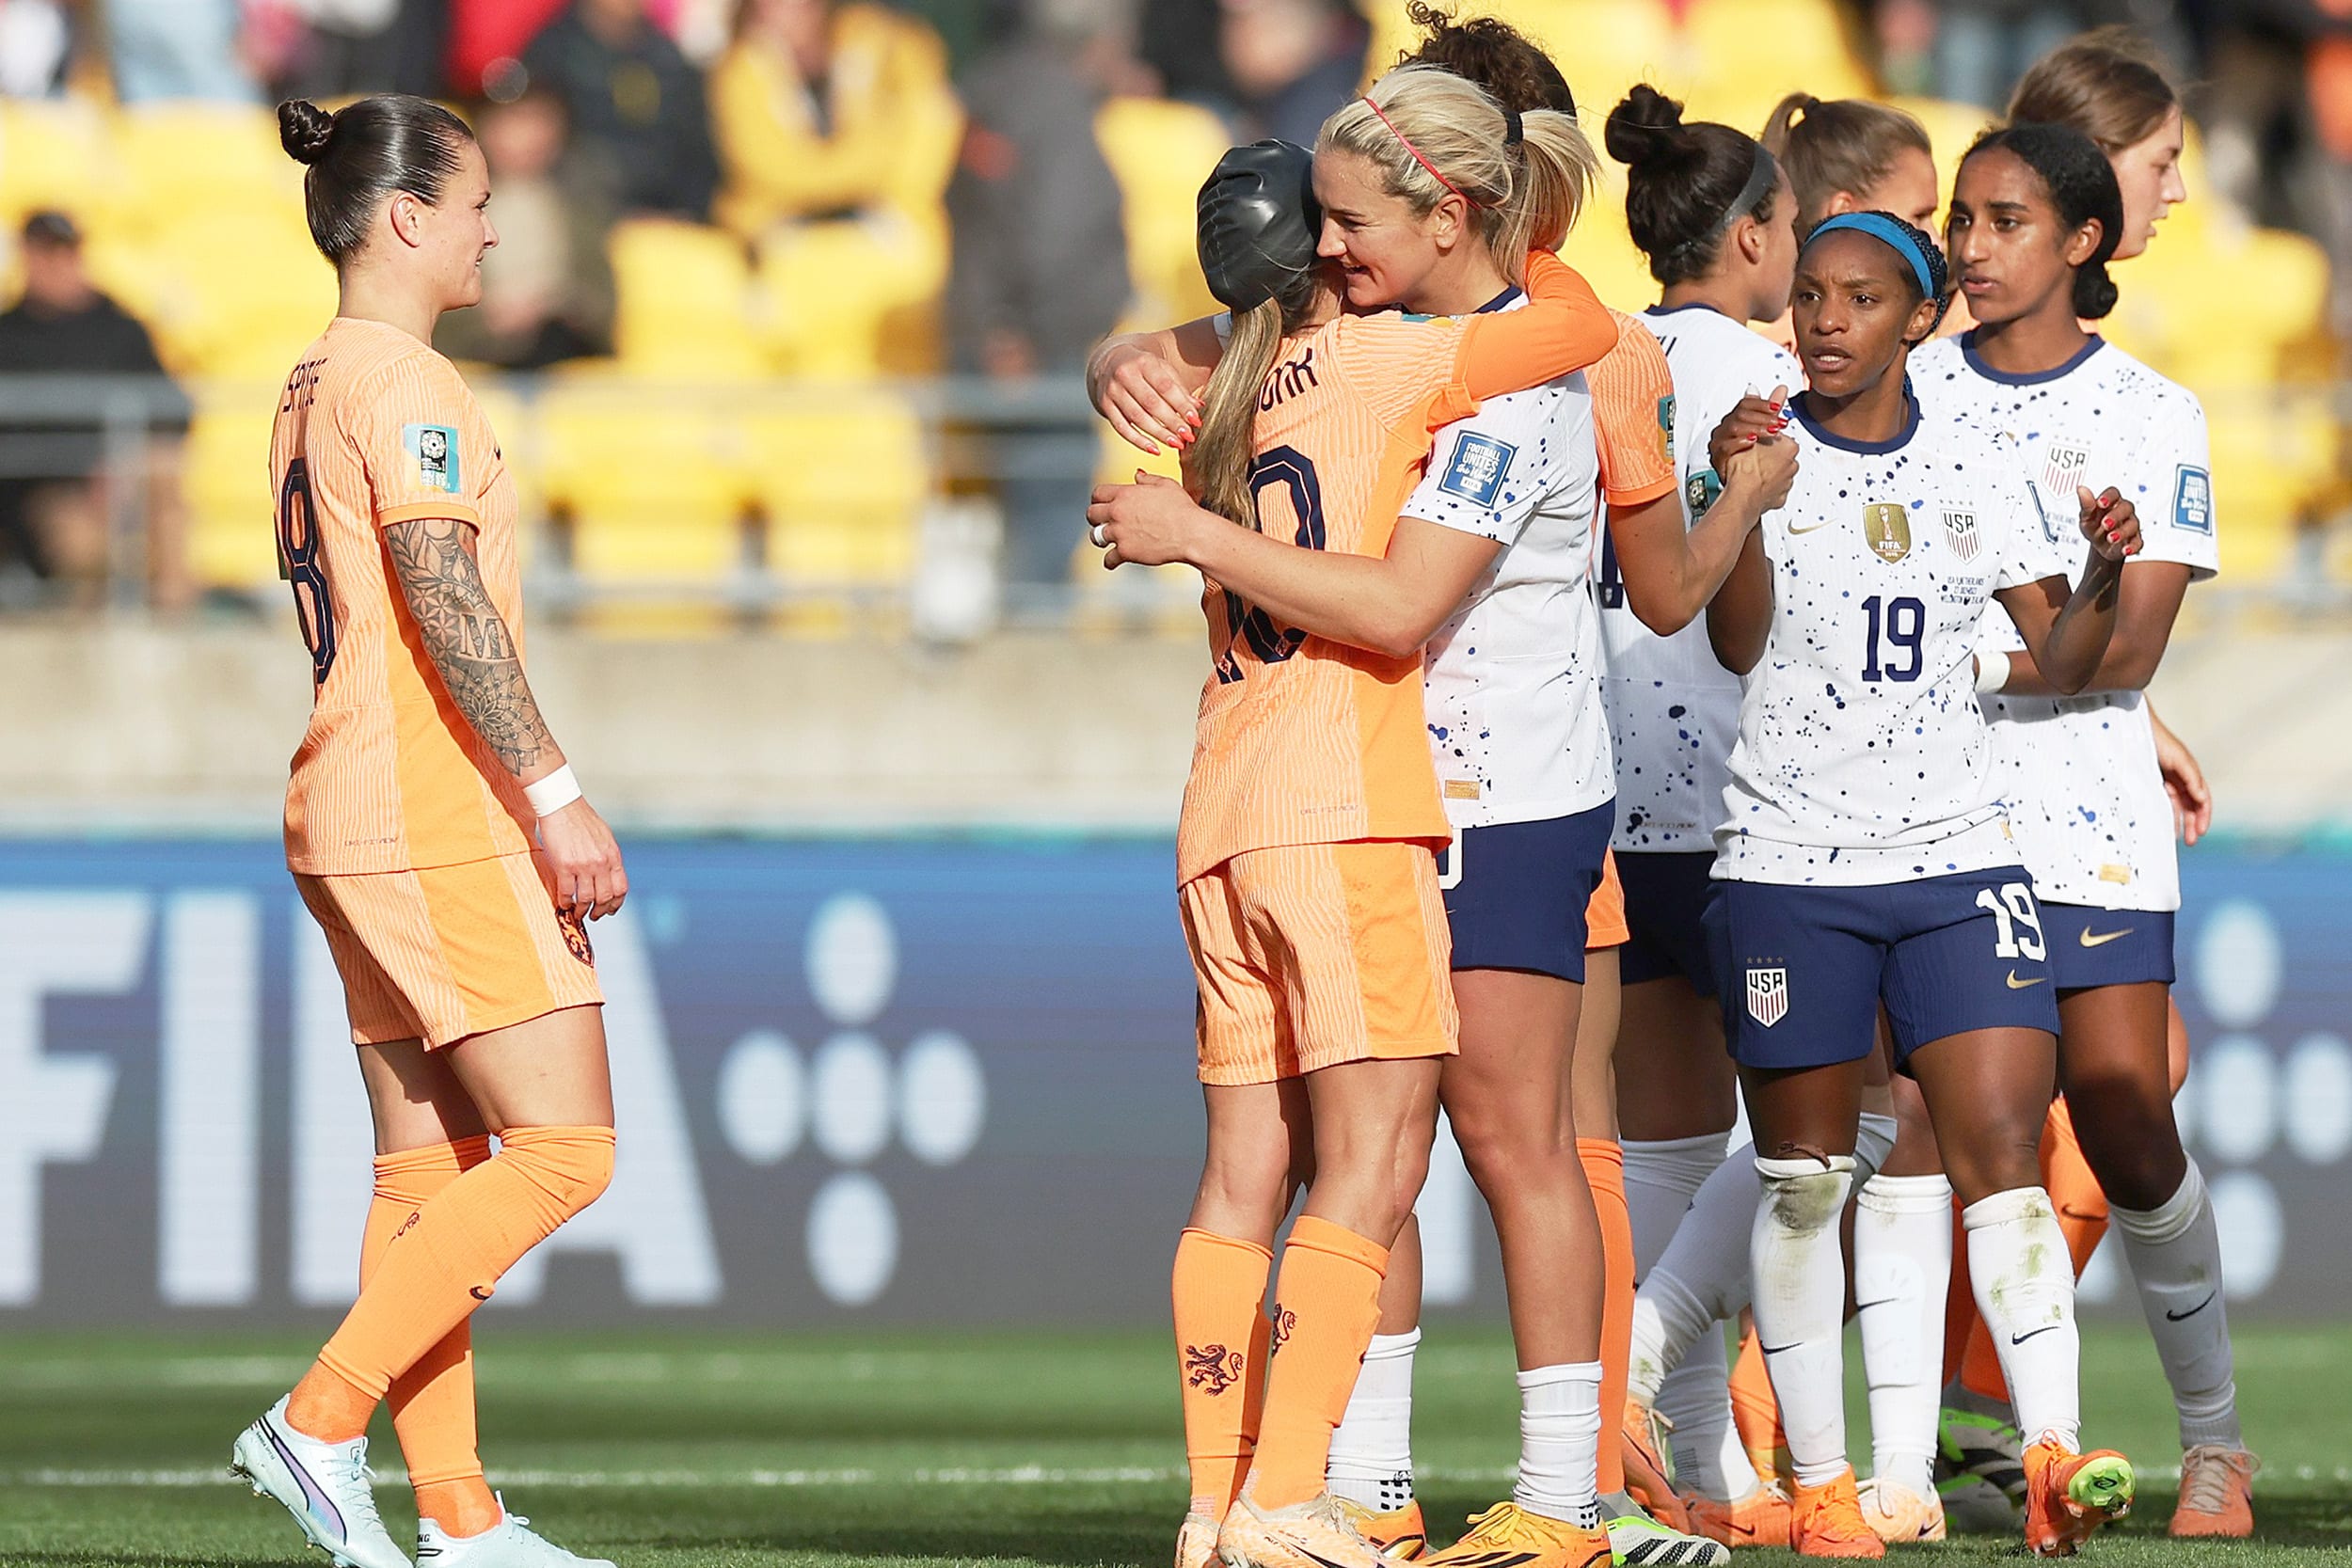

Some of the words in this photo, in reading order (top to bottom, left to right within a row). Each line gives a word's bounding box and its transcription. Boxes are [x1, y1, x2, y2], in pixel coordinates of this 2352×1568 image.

[1255, 347, 1319, 413] ONK
[1462, 451, 1499, 474] UNITES
[2050, 448, 2086, 469] USA
[1943, 513, 1974, 533] USA
[1878, 541, 1901, 550] FIFA
[1861, 595, 1926, 683] 19
[1975, 882, 2046, 962] 19
[1749, 972, 1783, 994] USA
